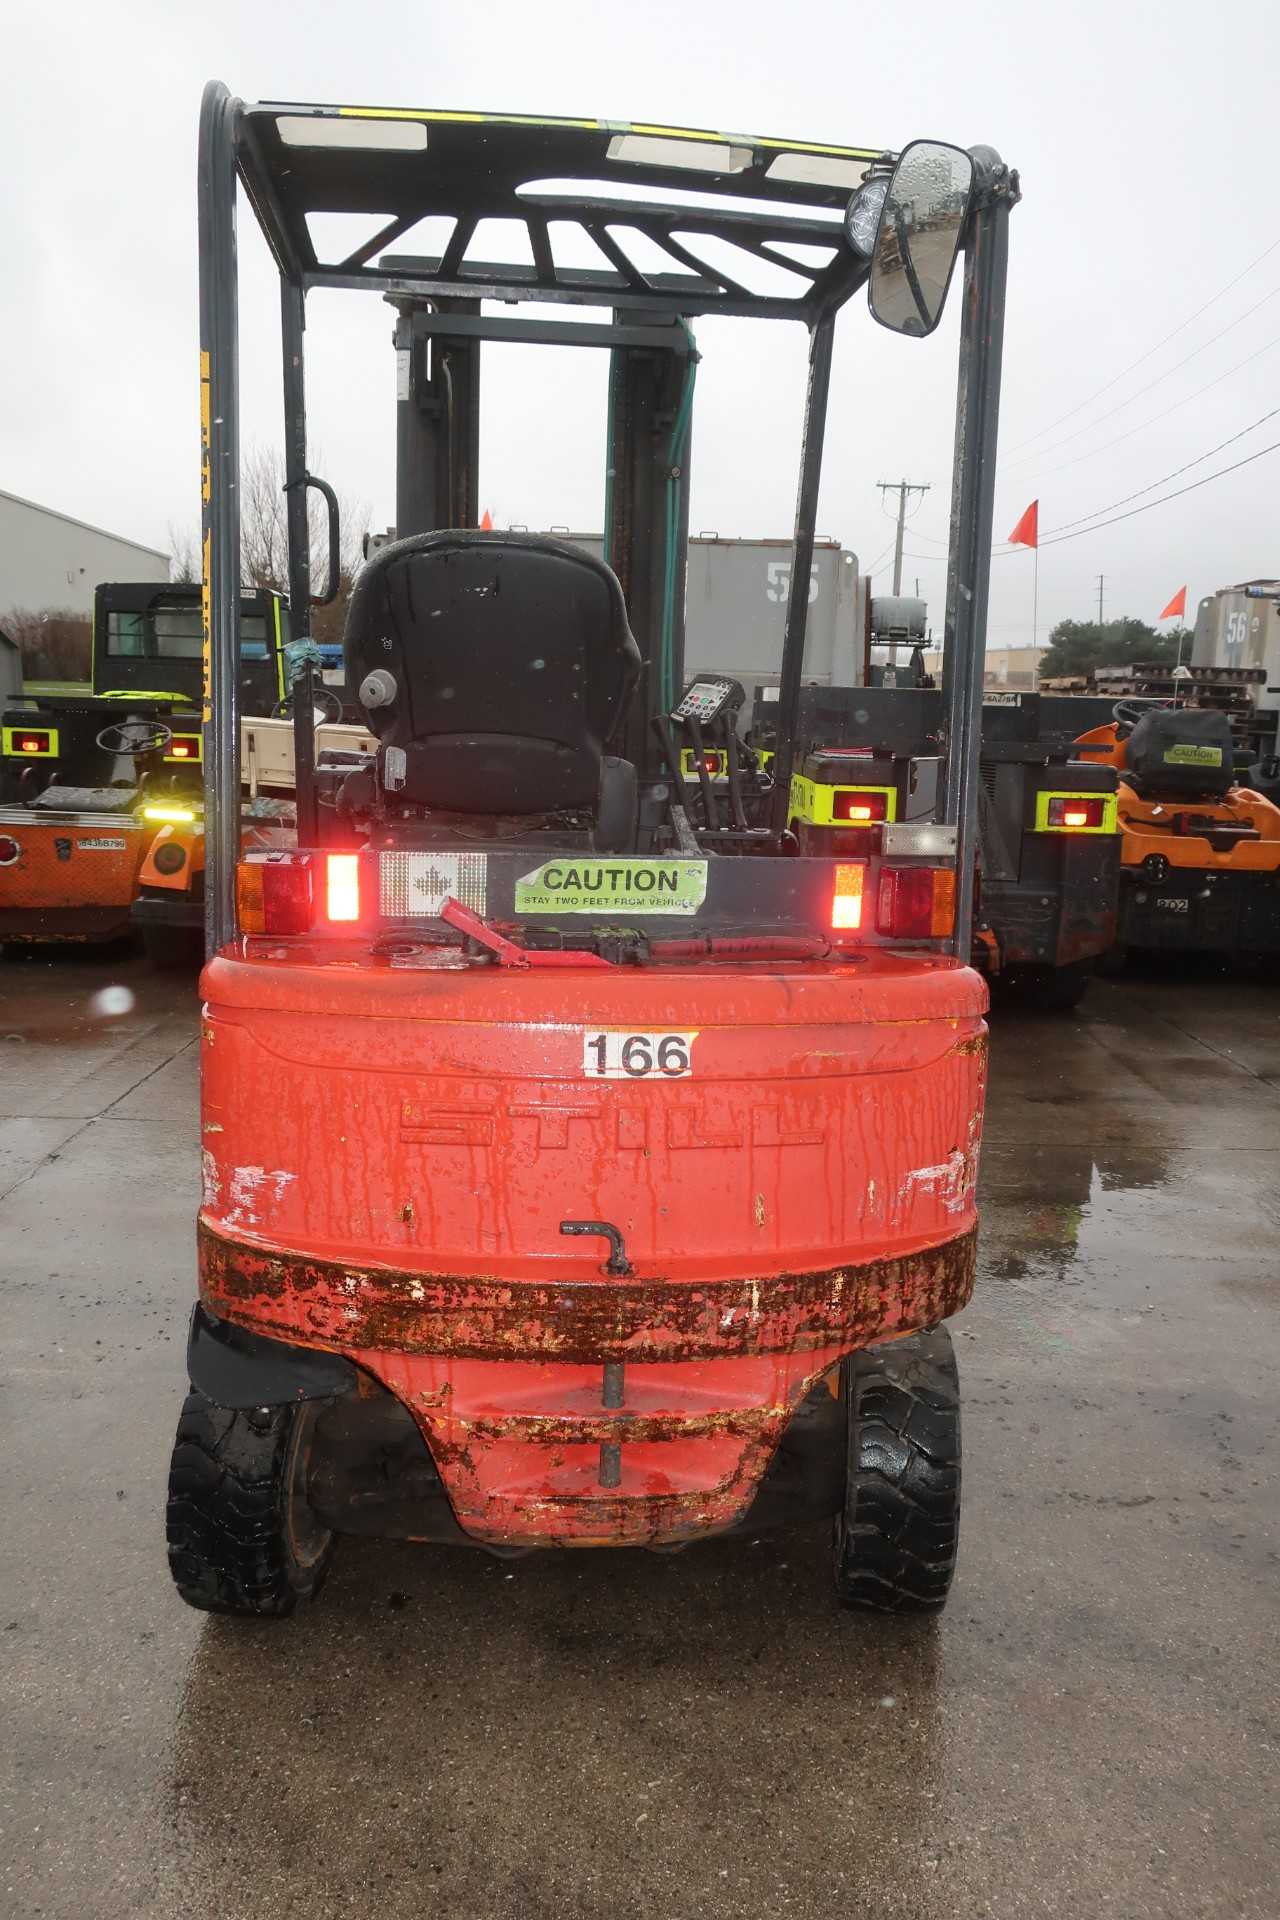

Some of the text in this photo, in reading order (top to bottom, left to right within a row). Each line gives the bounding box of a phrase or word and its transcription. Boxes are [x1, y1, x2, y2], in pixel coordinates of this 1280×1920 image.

[1174, 748, 1213, 759] CAUTION
[543, 867, 679, 892] CAUTION
[524, 896, 550, 904] STAY
[555, 897, 578, 905] TWO
[583, 897, 609, 905] FEET
[614, 898, 645, 906] FROM
[587, 1034, 689, 1077] 166
[399, 1098, 825, 1150] STILL
